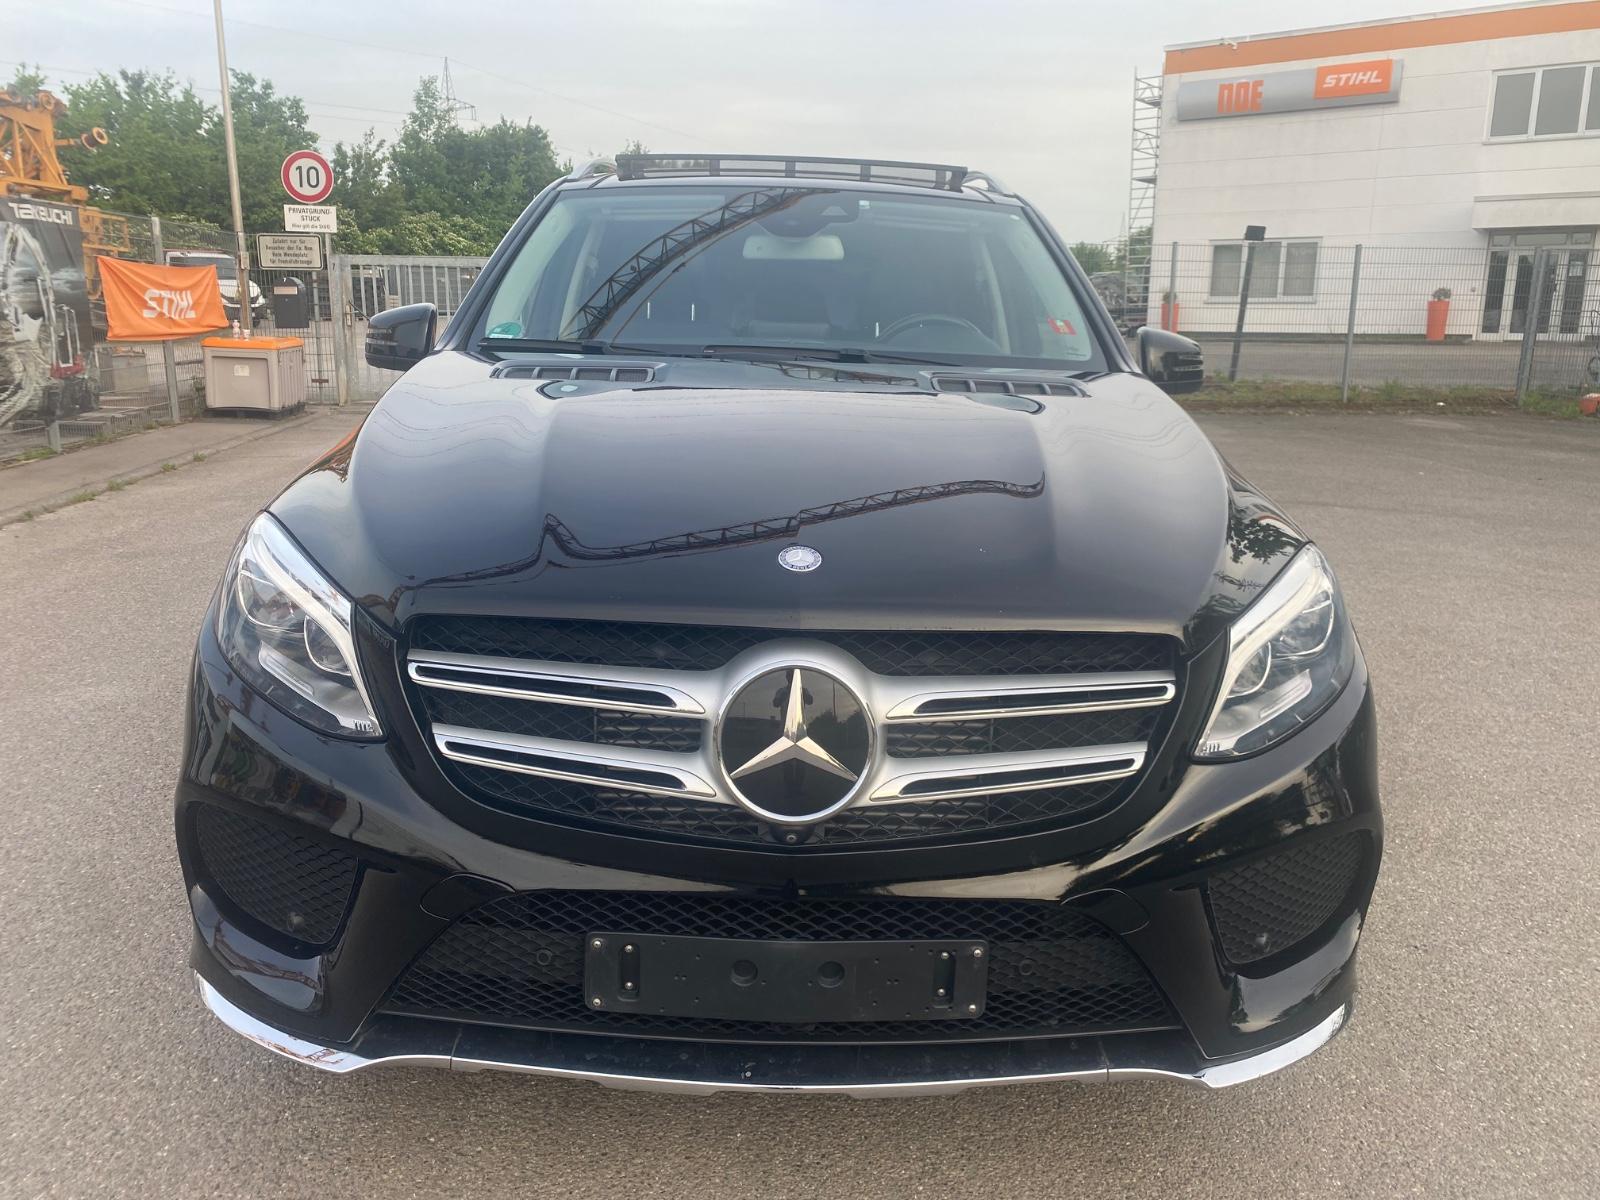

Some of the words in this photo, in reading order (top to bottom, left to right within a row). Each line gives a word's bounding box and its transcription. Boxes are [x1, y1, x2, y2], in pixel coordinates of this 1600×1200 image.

[1322, 70, 1382, 88] STIHL
[295, 165, 320, 189] 10
[143, 288, 197, 317] STIHL
